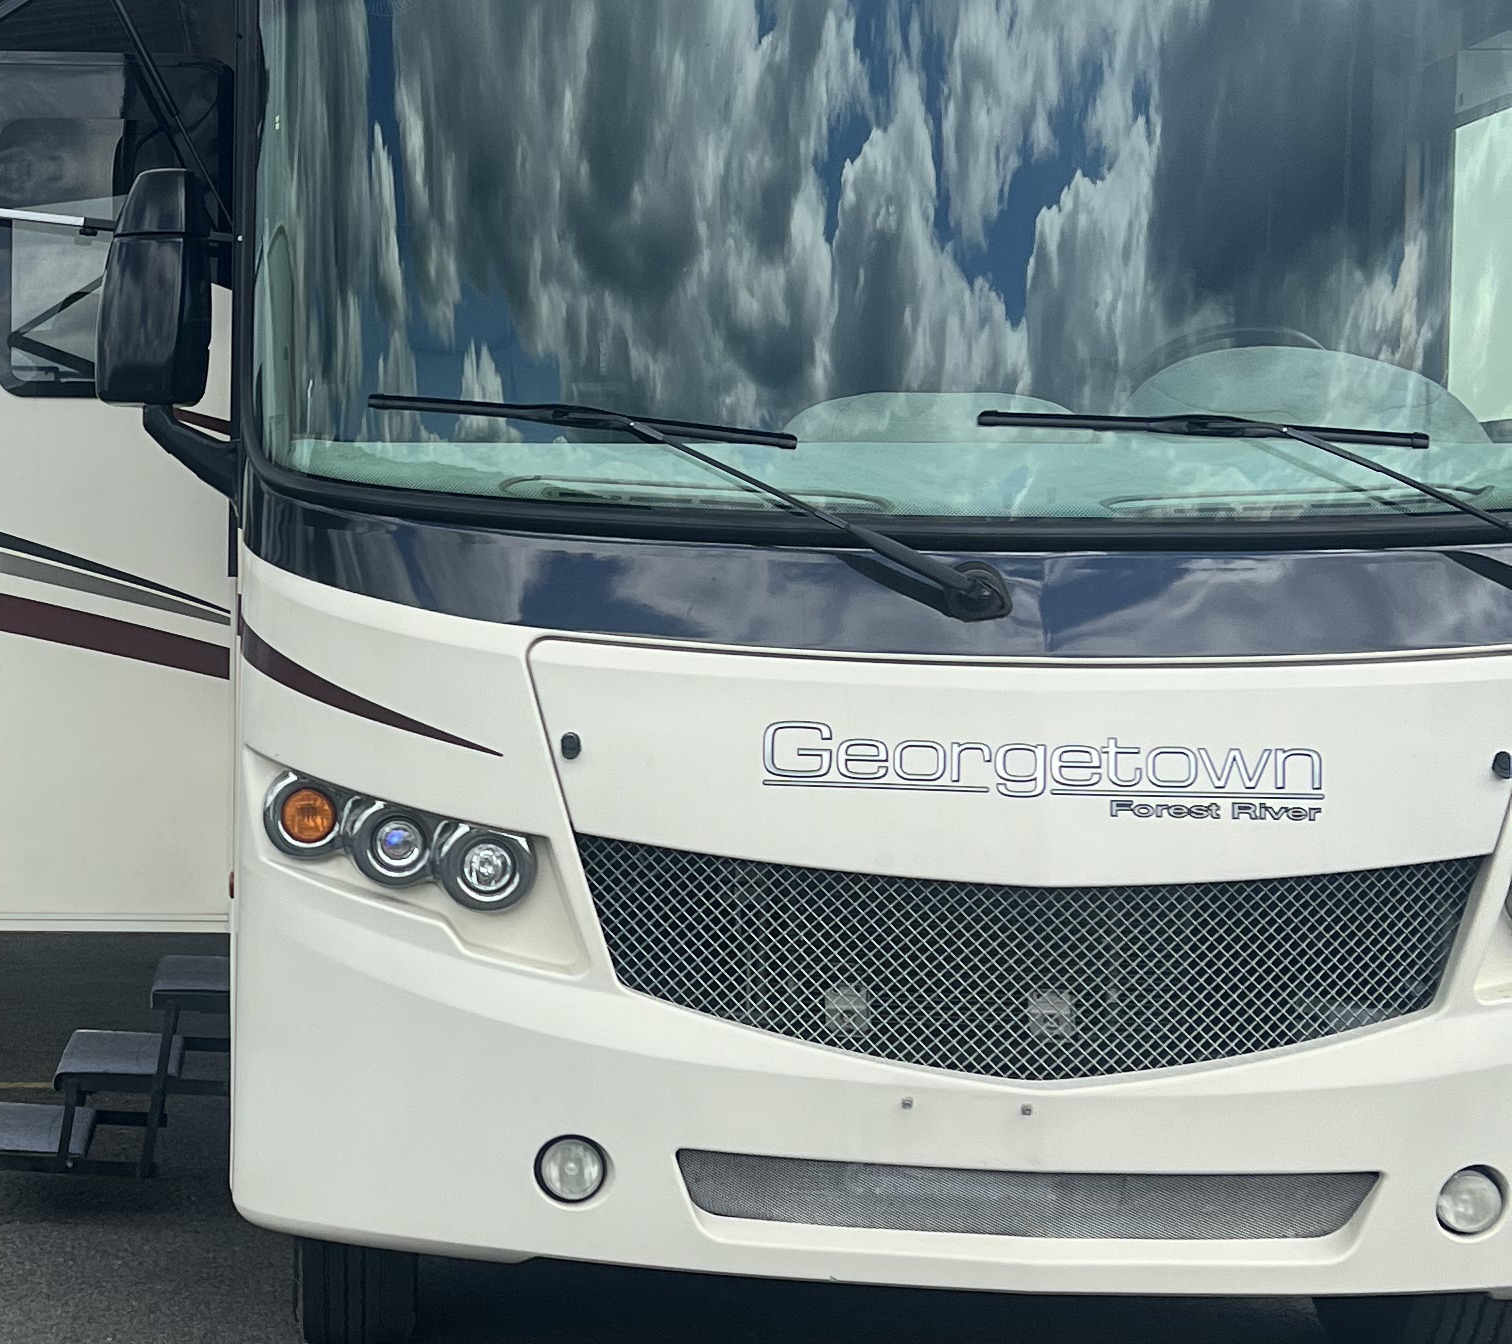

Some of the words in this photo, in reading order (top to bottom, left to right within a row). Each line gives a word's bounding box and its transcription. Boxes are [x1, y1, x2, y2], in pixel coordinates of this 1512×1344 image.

[762, 720, 1323, 798] Georgetown
[1109, 799, 1221, 820] Forest
[1231, 802, 1322, 822] River
